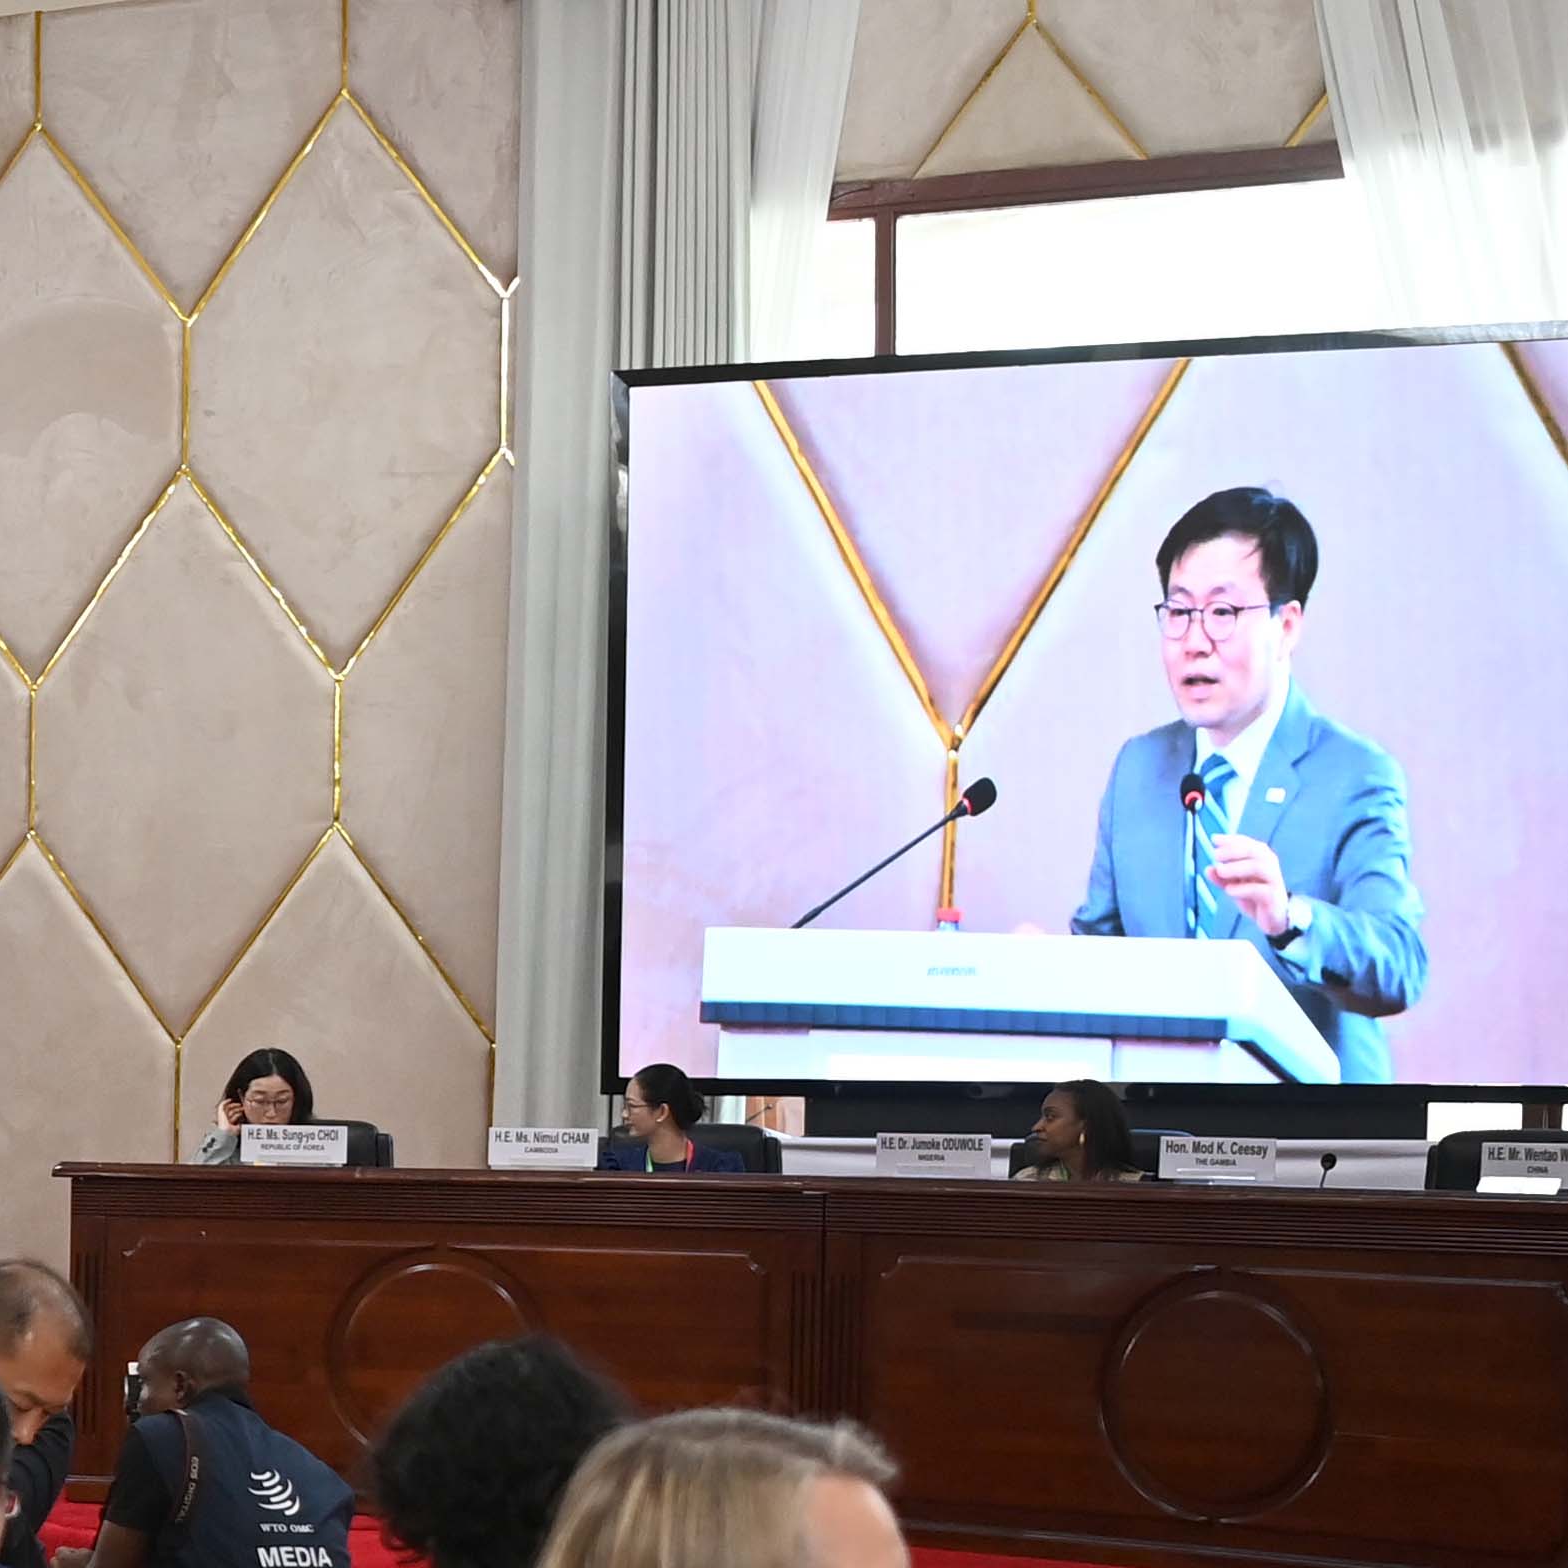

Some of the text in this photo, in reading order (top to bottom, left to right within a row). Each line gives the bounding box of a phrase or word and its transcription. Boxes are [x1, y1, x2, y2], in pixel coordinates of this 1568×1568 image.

[266, 1128, 280, 1140] Ms.
[317, 1129, 339, 1141] CHOI
[494, 1130, 513, 1143] H.E.
[515, 1131, 531, 1143] Ms.
[561, 1131, 590, 1144] CHAM
[942, 1137, 983, 1151] ODUWOLE
[1165, 1140, 1268, 1159] Hon. Mod K. Ceesay
[259, 1523, 288, 1533] WTO
[256, 1545, 333, 1568] MEDIA
